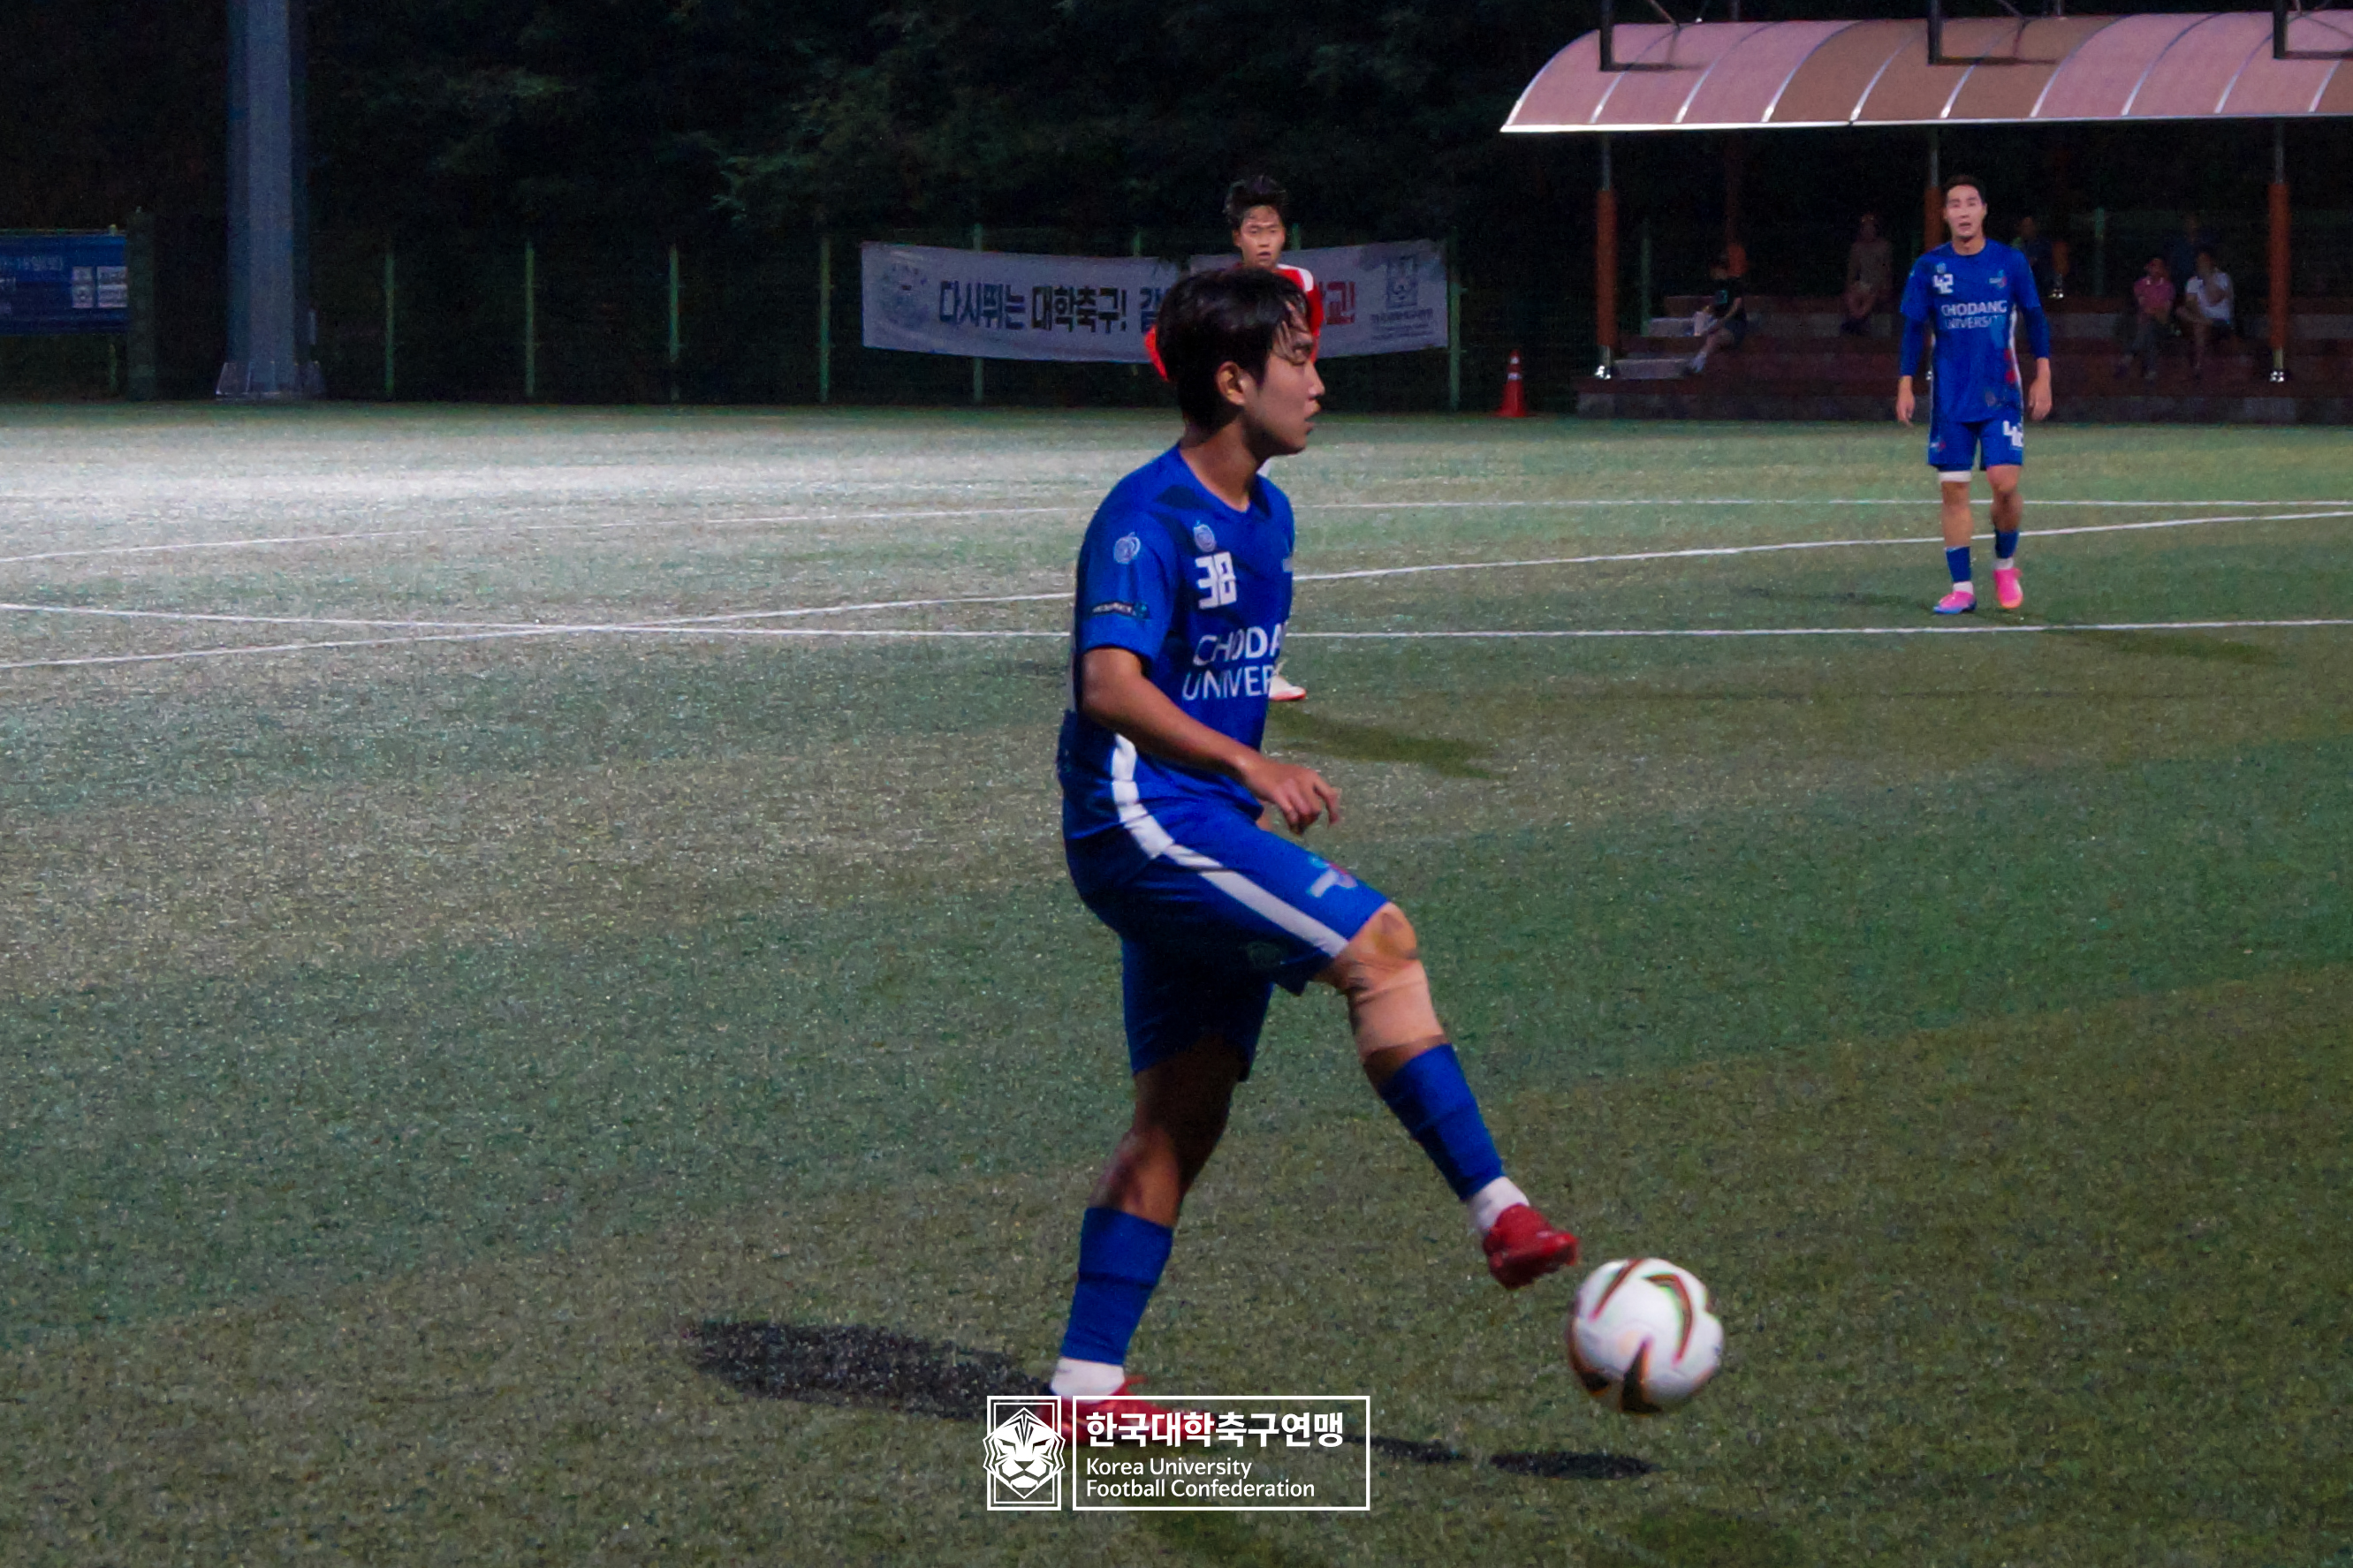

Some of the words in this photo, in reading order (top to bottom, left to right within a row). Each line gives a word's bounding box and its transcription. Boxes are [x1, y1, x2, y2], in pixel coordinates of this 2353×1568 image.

[1932, 273, 1955, 294] 42
[939, 280, 1024, 330] 다시뛰는
[1032, 284, 1127, 334] 대학축구!
[1940, 299, 2008, 317] CHODANG
[1194, 551, 1237, 610] 38
